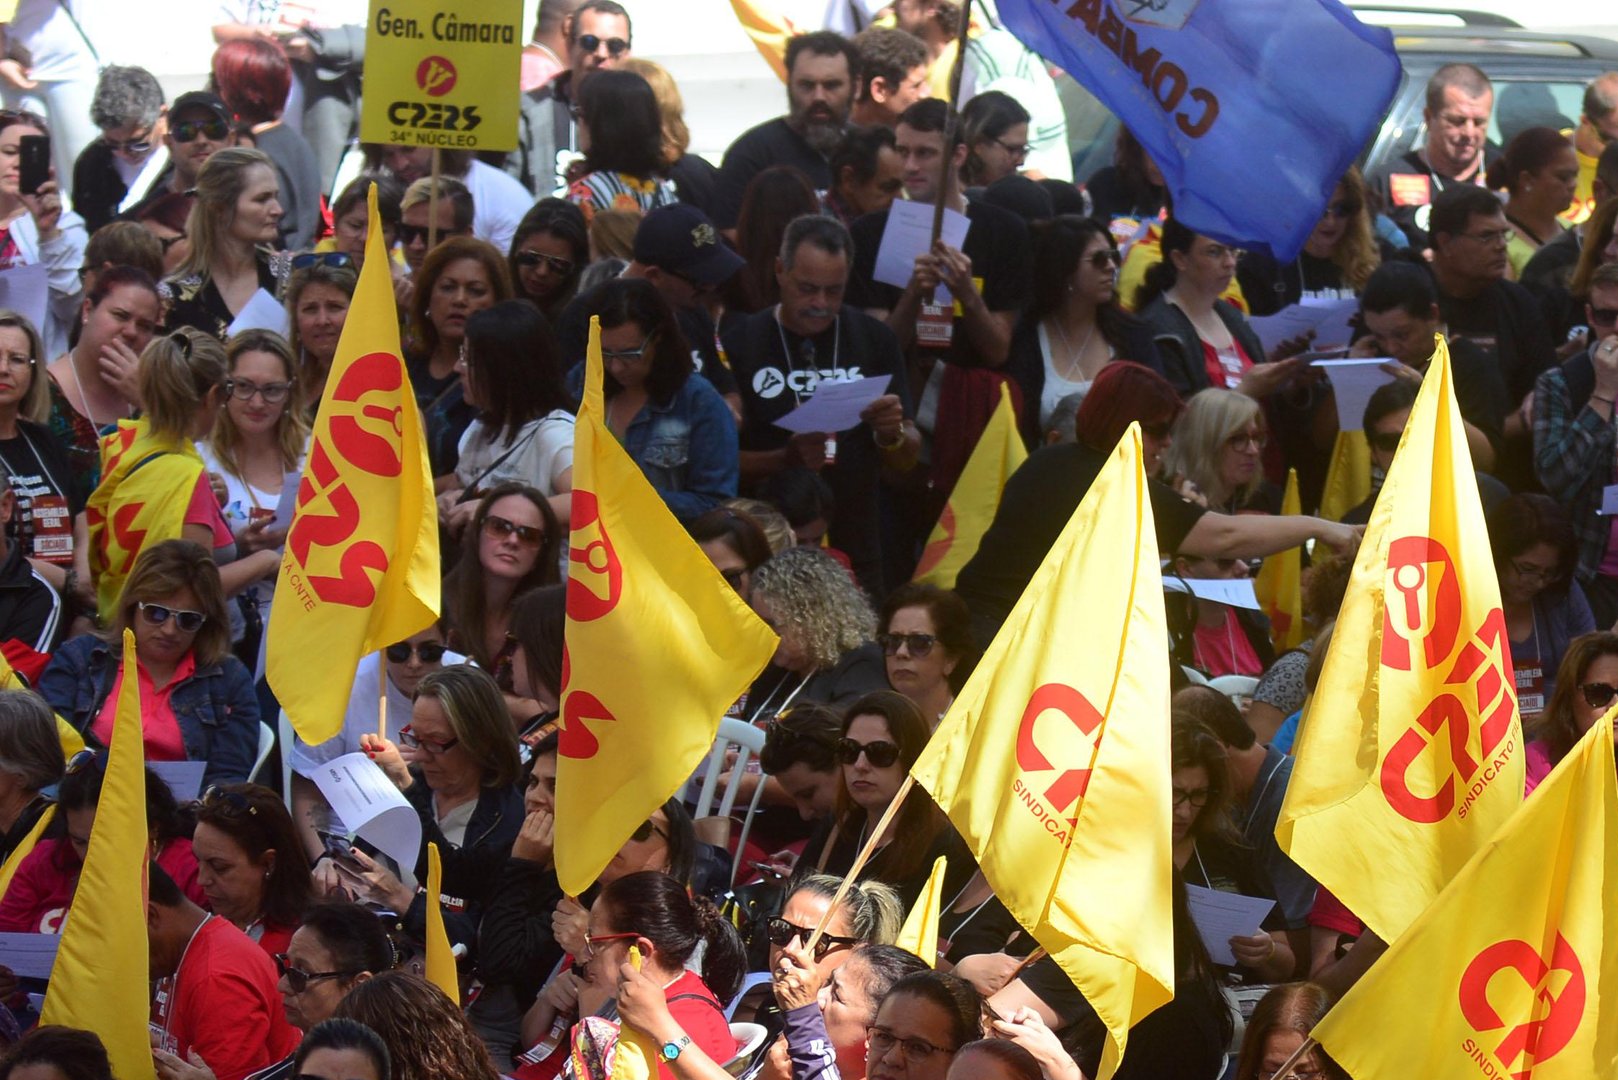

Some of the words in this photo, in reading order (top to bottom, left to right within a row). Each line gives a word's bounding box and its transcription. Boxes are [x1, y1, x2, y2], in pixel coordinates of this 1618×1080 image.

[375, 9, 424, 40] Gen.
[431, 12, 515, 45] Câmara
[416, 130, 478, 147] NÚCLEO
[289, 573, 316, 613] CNTE
[1457, 741, 1515, 820] SINDICATO
